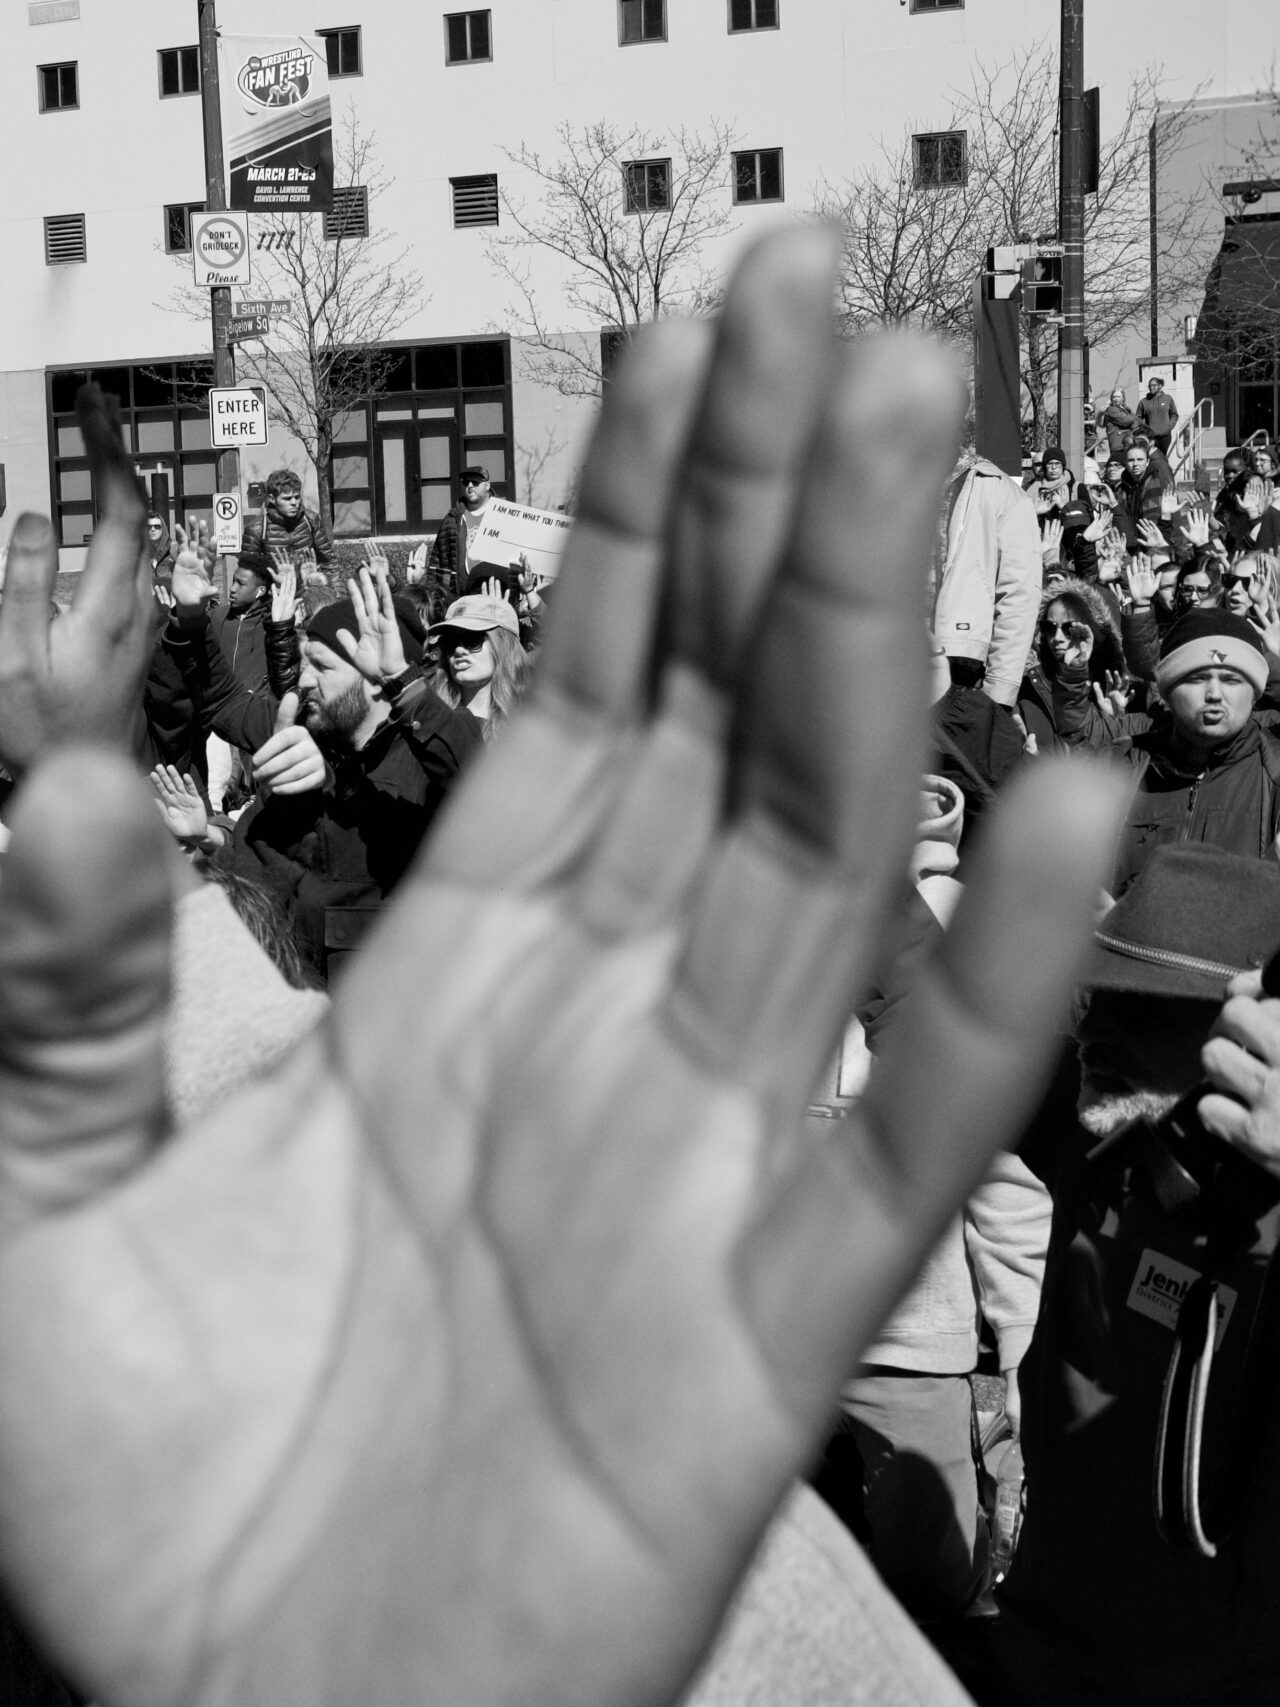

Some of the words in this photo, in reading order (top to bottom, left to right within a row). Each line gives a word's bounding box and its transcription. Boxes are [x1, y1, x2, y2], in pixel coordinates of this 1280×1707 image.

[248, 66, 276, 90] FAN
[279, 55, 314, 86] FEST
[247, 168, 285, 181] MARCH
[253, 195, 289, 203] CONVENTION
[289, 195, 311, 203] CENTER
[209, 231, 231, 240] DON'T
[202, 242, 239, 251] GRIDLOCK
[206, 272, 239, 284] Please
[241, 303, 266, 314] Sixth
[270, 302, 288, 313] Ave
[228, 320, 253, 337] Bigelow
[256, 315, 268, 333] Sq
[217, 400, 260, 414] ENTER
[222, 422, 257, 436] HERE
[508, 508, 521, 517] NOT
[522, 512, 541, 522] WHAT
[542, 517, 553, 526] YOU
[482, 527, 488, 536] I
[488, 528, 500, 538] AM
[1135, 1286, 1174, 1311] District
